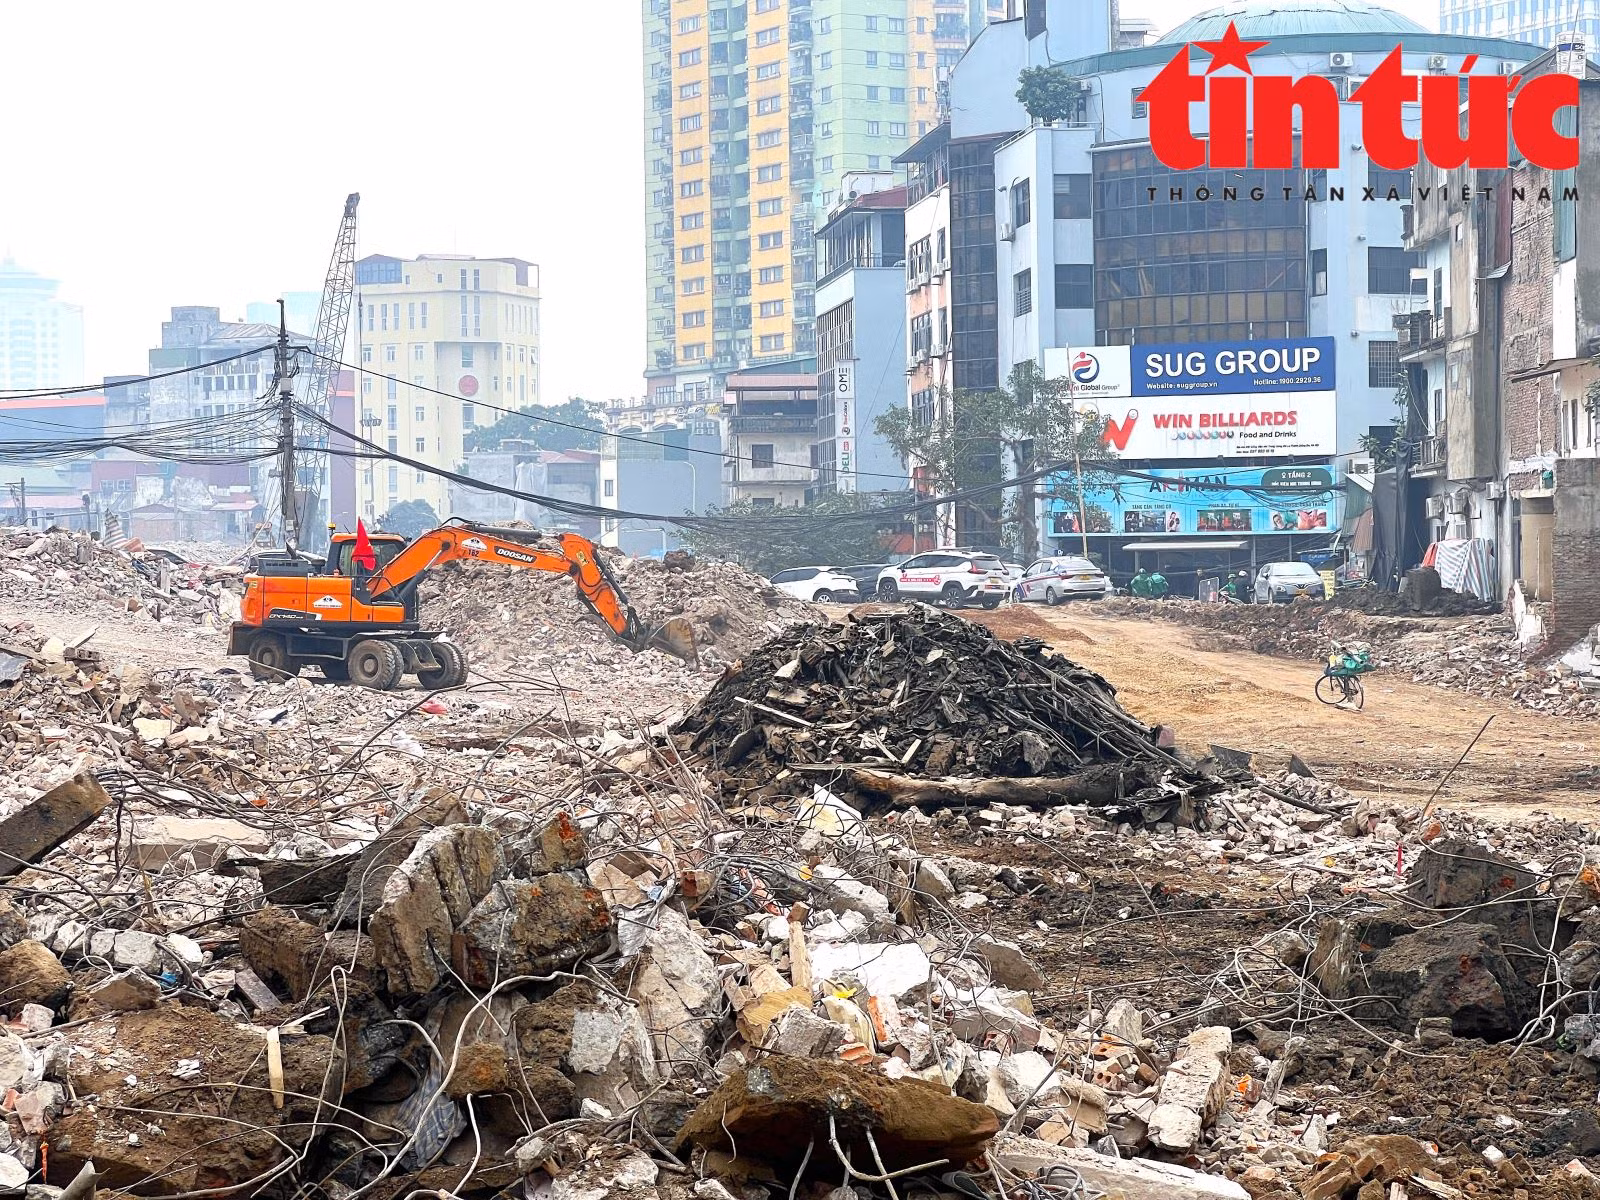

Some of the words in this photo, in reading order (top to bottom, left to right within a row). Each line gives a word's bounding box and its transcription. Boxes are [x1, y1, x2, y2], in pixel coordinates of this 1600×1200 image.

[1145, 352, 1206, 378] SUG
[1215, 347, 1321, 375] GROUP
[1176, 381, 1218, 390] suggroup.vn
[1153, 413, 1193, 429] WIN
[1199, 411, 1297, 428] BILLIARDS
[1239, 431, 1258, 439] Food
[1274, 430, 1297, 438] Drinks
[496, 548, 534, 562] DOOSAN
